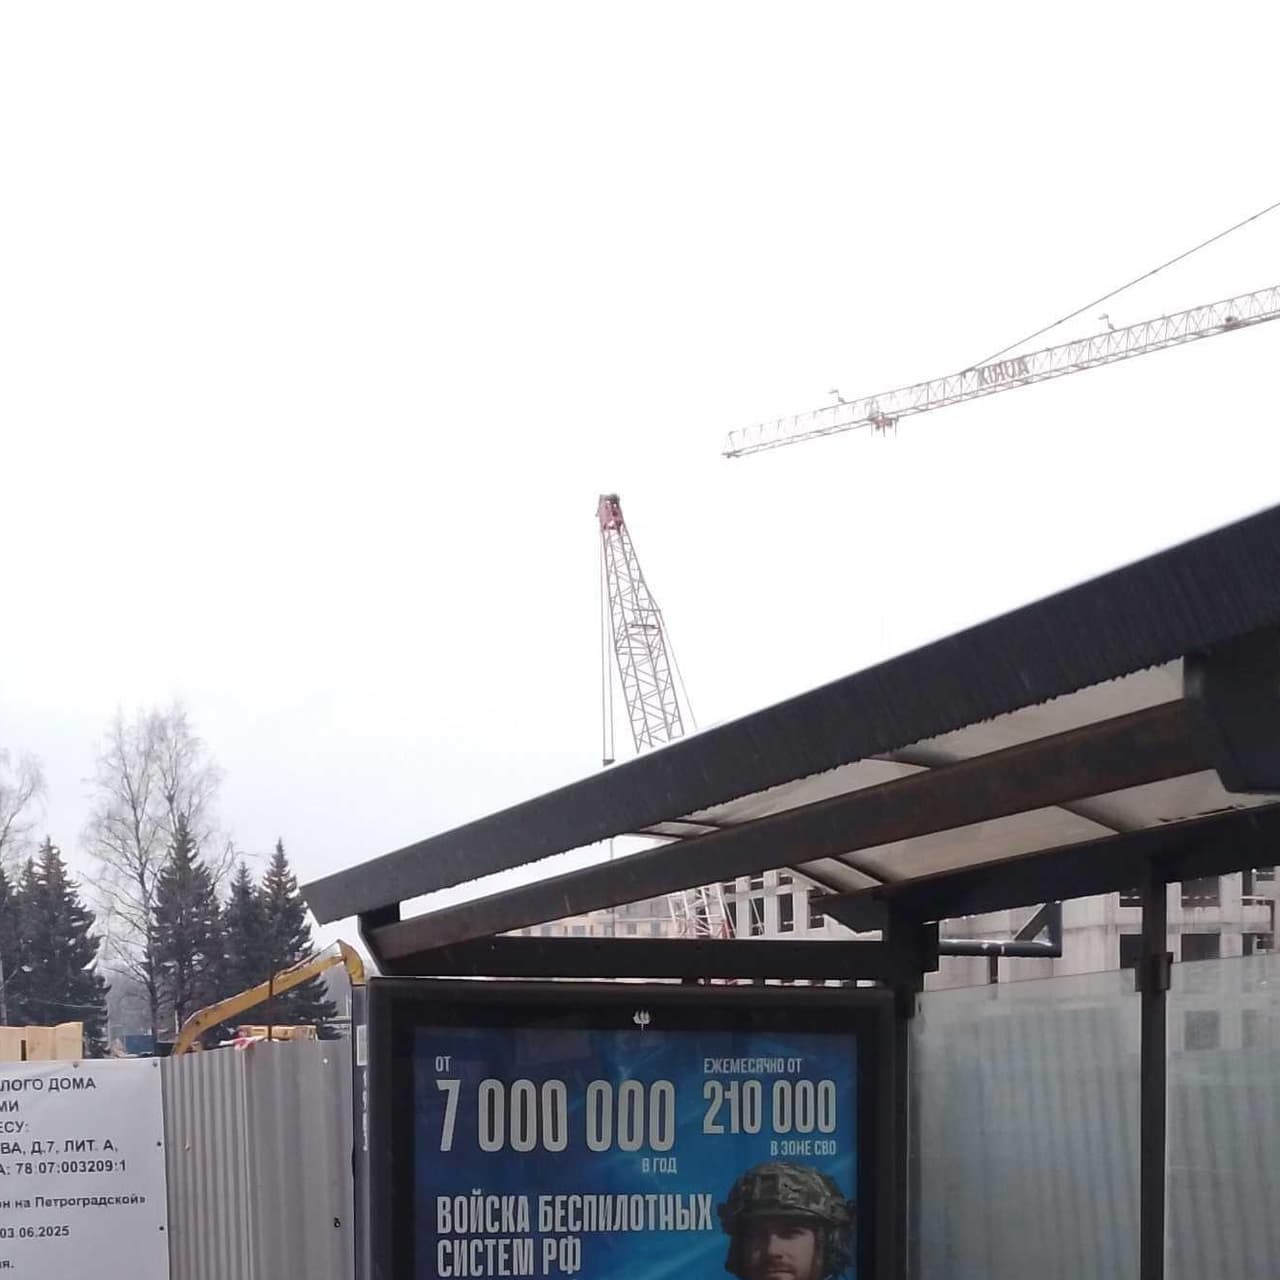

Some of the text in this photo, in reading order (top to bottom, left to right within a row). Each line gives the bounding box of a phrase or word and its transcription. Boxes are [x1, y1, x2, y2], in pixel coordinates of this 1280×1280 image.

[435, 1055, 452, 1072] ОТ
[703, 1056, 802, 1075] ЕЖЕМЕСЯЧНО ОТ
[47, 1077, 97, 1092] ДОМА
[436, 1079, 462, 1153] 7
[478, 1079, 569, 1153] 000
[586, 1078, 676, 1153] 000
[702, 1079, 836, 1135] 210 000
[102, 1139, 119, 1151] А,
[769, 1139, 837, 1158] В ЗОНЕ СВО
[642, 1156, 678, 1176] В ГОД
[14, 1200, 32, 1208] на
[34, 1194, 146, 1208] Петроградской»
[436, 1188, 714, 1235] ВОЙСКА БЕСПИЛОТНЫХ
[436, 1237, 582, 1279] СИСТЕМ РФ
